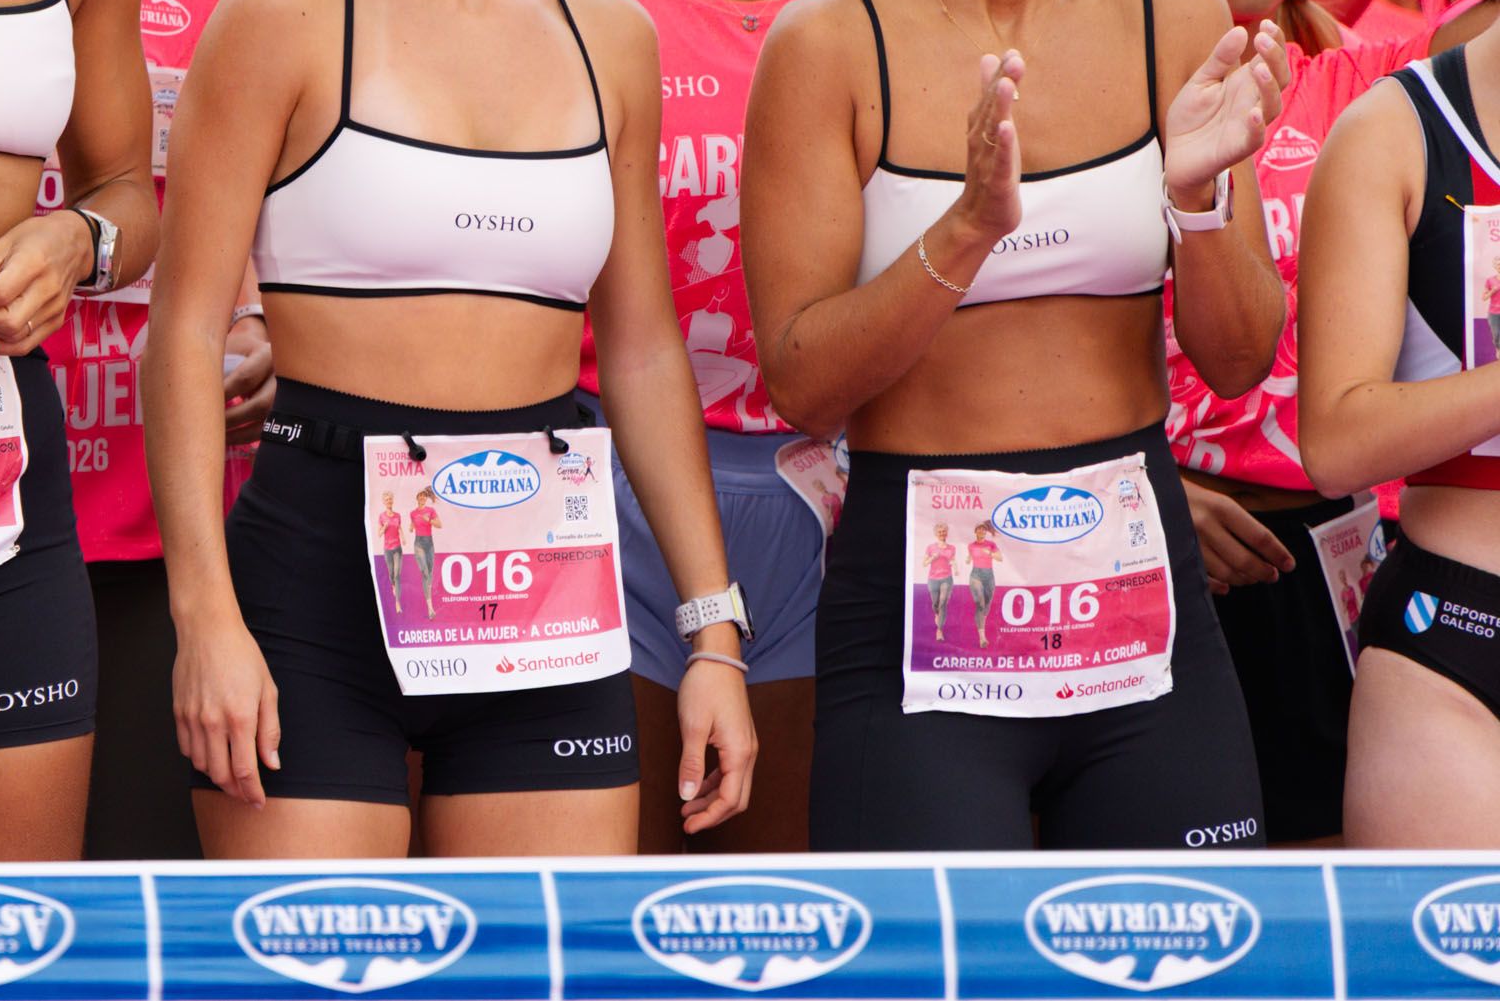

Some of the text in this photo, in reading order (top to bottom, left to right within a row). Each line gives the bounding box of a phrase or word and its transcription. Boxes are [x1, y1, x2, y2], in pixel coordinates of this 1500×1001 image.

[140, 10, 184, 28] URIANA
[662, 74, 720, 99] SHO
[455, 213, 534, 233] OYSHO
[992, 228, 1069, 255] OYSHO
[263, 418, 302, 442] alenji
[376, 452, 387, 461] TU
[379, 461, 425, 477] SUMA
[442, 472, 534, 495] ASTURIANA
[930, 485, 982, 494] TU DORSAL
[931, 495, 983, 510] SUMA
[1001, 507, 1096, 529] ASTURIANA
[1330, 535, 1363, 559] SUMA
[441, 551, 533, 595] 016
[479, 603, 498, 621] 17
[1001, 582, 1100, 627] 016
[398, 617, 599, 644] CARRERA DE LA MUJER A CORUÑA
[1439, 613, 1495, 639] GALEGO
[1041, 633, 1062, 650] 18
[518, 651, 600, 672] Santander
[933, 640, 1147, 669] CARRERA DE LA MUJER A CORUÑA
[407, 658, 467, 679] OYSHO
[938, 683, 1022, 701] OYSHO
[1076, 674, 1145, 697] Santander
[553, 734, 632, 757] OYSHO
[1185, 817, 1257, 848] OYSHO
[251, 904, 456, 950] ASTURIANA
[650, 903, 854, 949] ASTURIANA
[1041, 902, 1243, 949] ASTURIANA
